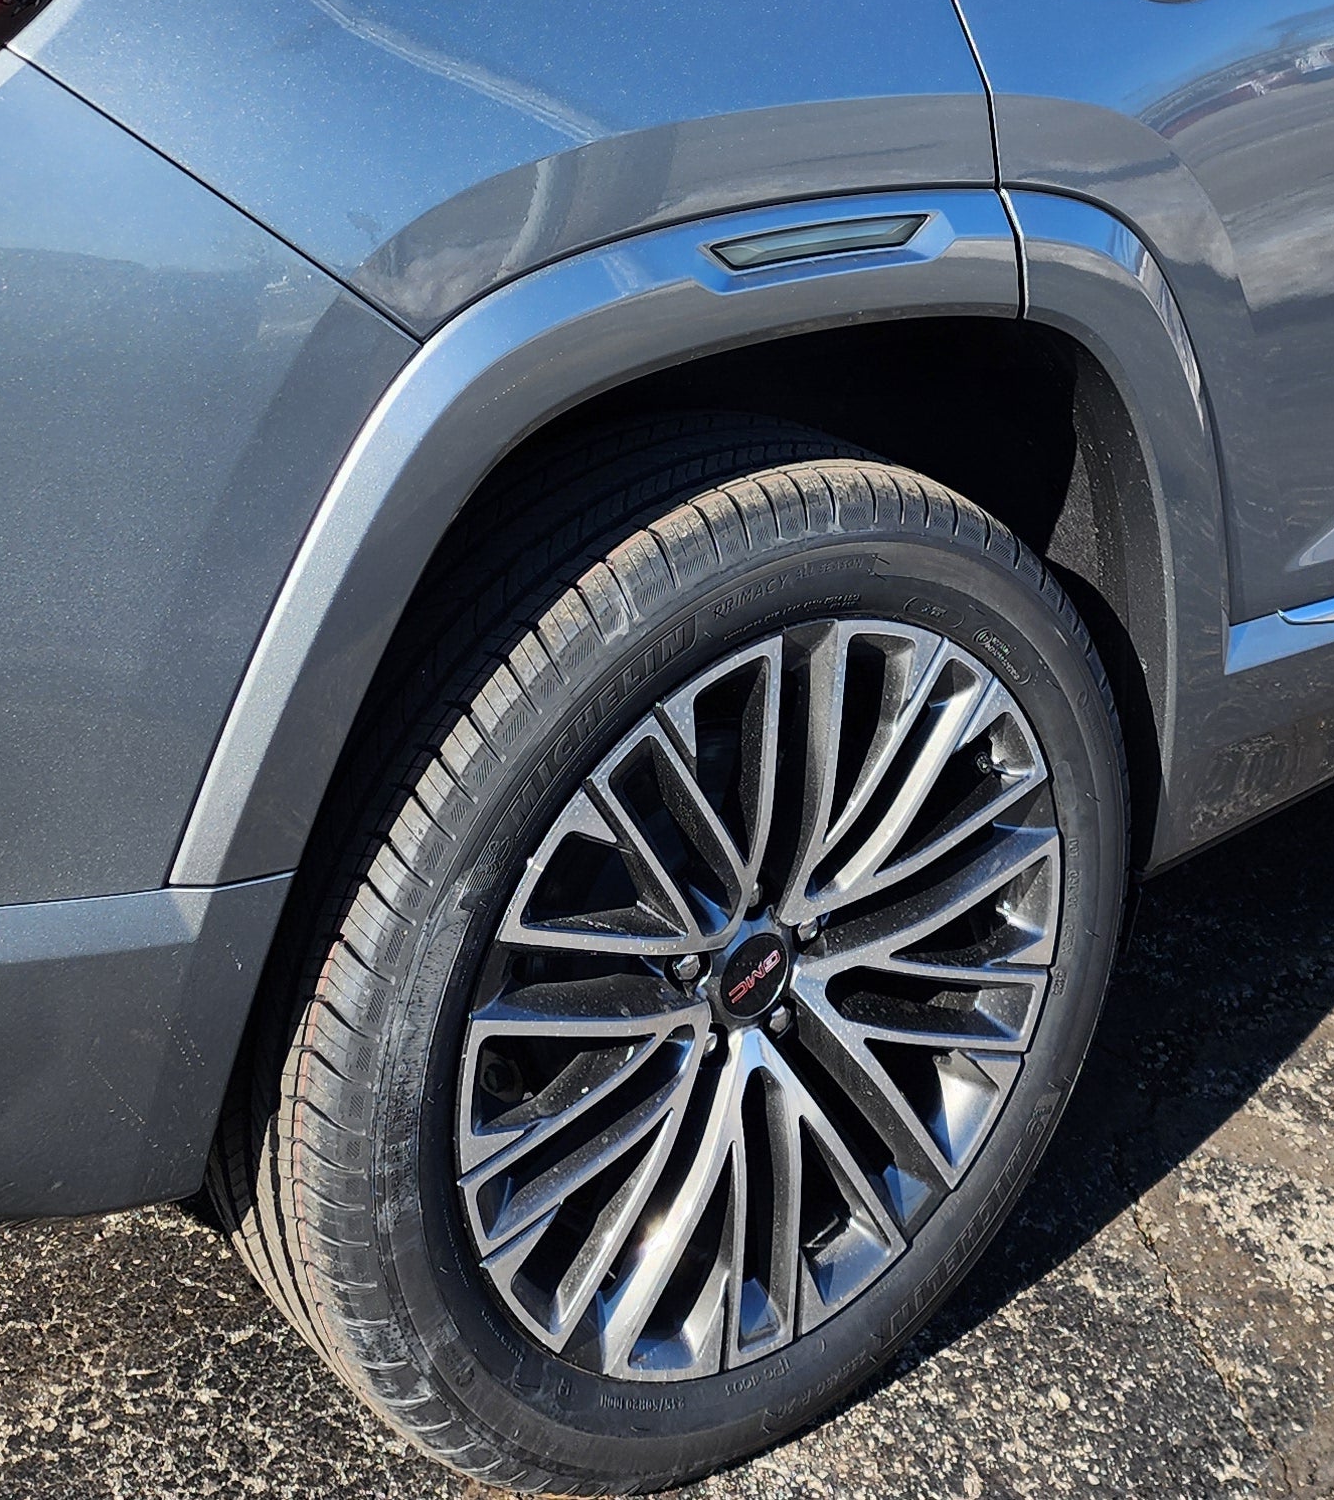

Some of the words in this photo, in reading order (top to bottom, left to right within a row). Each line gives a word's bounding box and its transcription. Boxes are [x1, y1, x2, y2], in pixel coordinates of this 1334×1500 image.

[713, 574, 790, 621] PRIMACY
[509, 625, 687, 830] MICHELIN
[728, 949, 781, 1004] GMC
[889, 1145, 1029, 1339] MICHELIN
